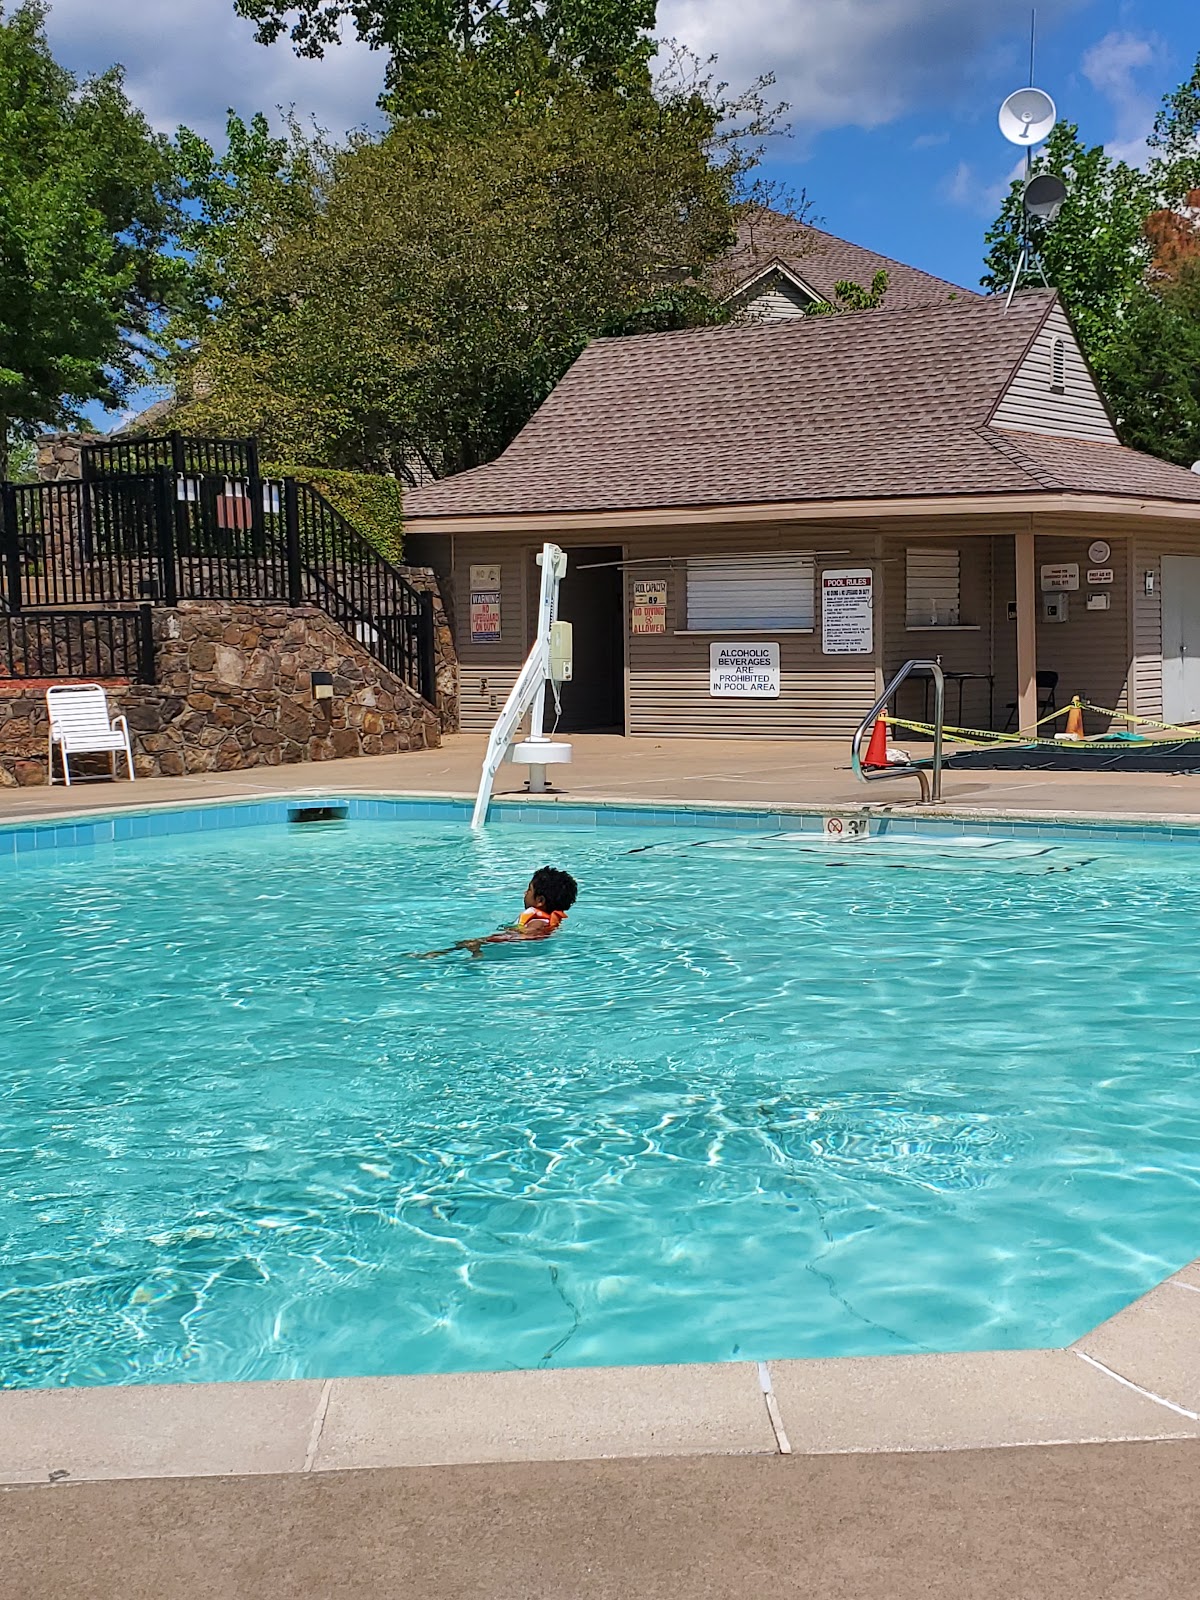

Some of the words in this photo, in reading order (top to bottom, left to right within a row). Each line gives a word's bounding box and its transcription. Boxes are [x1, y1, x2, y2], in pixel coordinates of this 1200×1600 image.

[472, 594, 500, 604] WARNING
[482, 604, 490, 613] NO
[634, 608, 642, 616] NO
[644, 607, 664, 616] DIVING
[473, 613, 500, 622] LIFEGUARD
[476, 622, 482, 632] ON
[484, 622, 496, 632] DUTY
[634, 624, 664, 633] ALLOWED
[848, 820, 858, 834] 3
